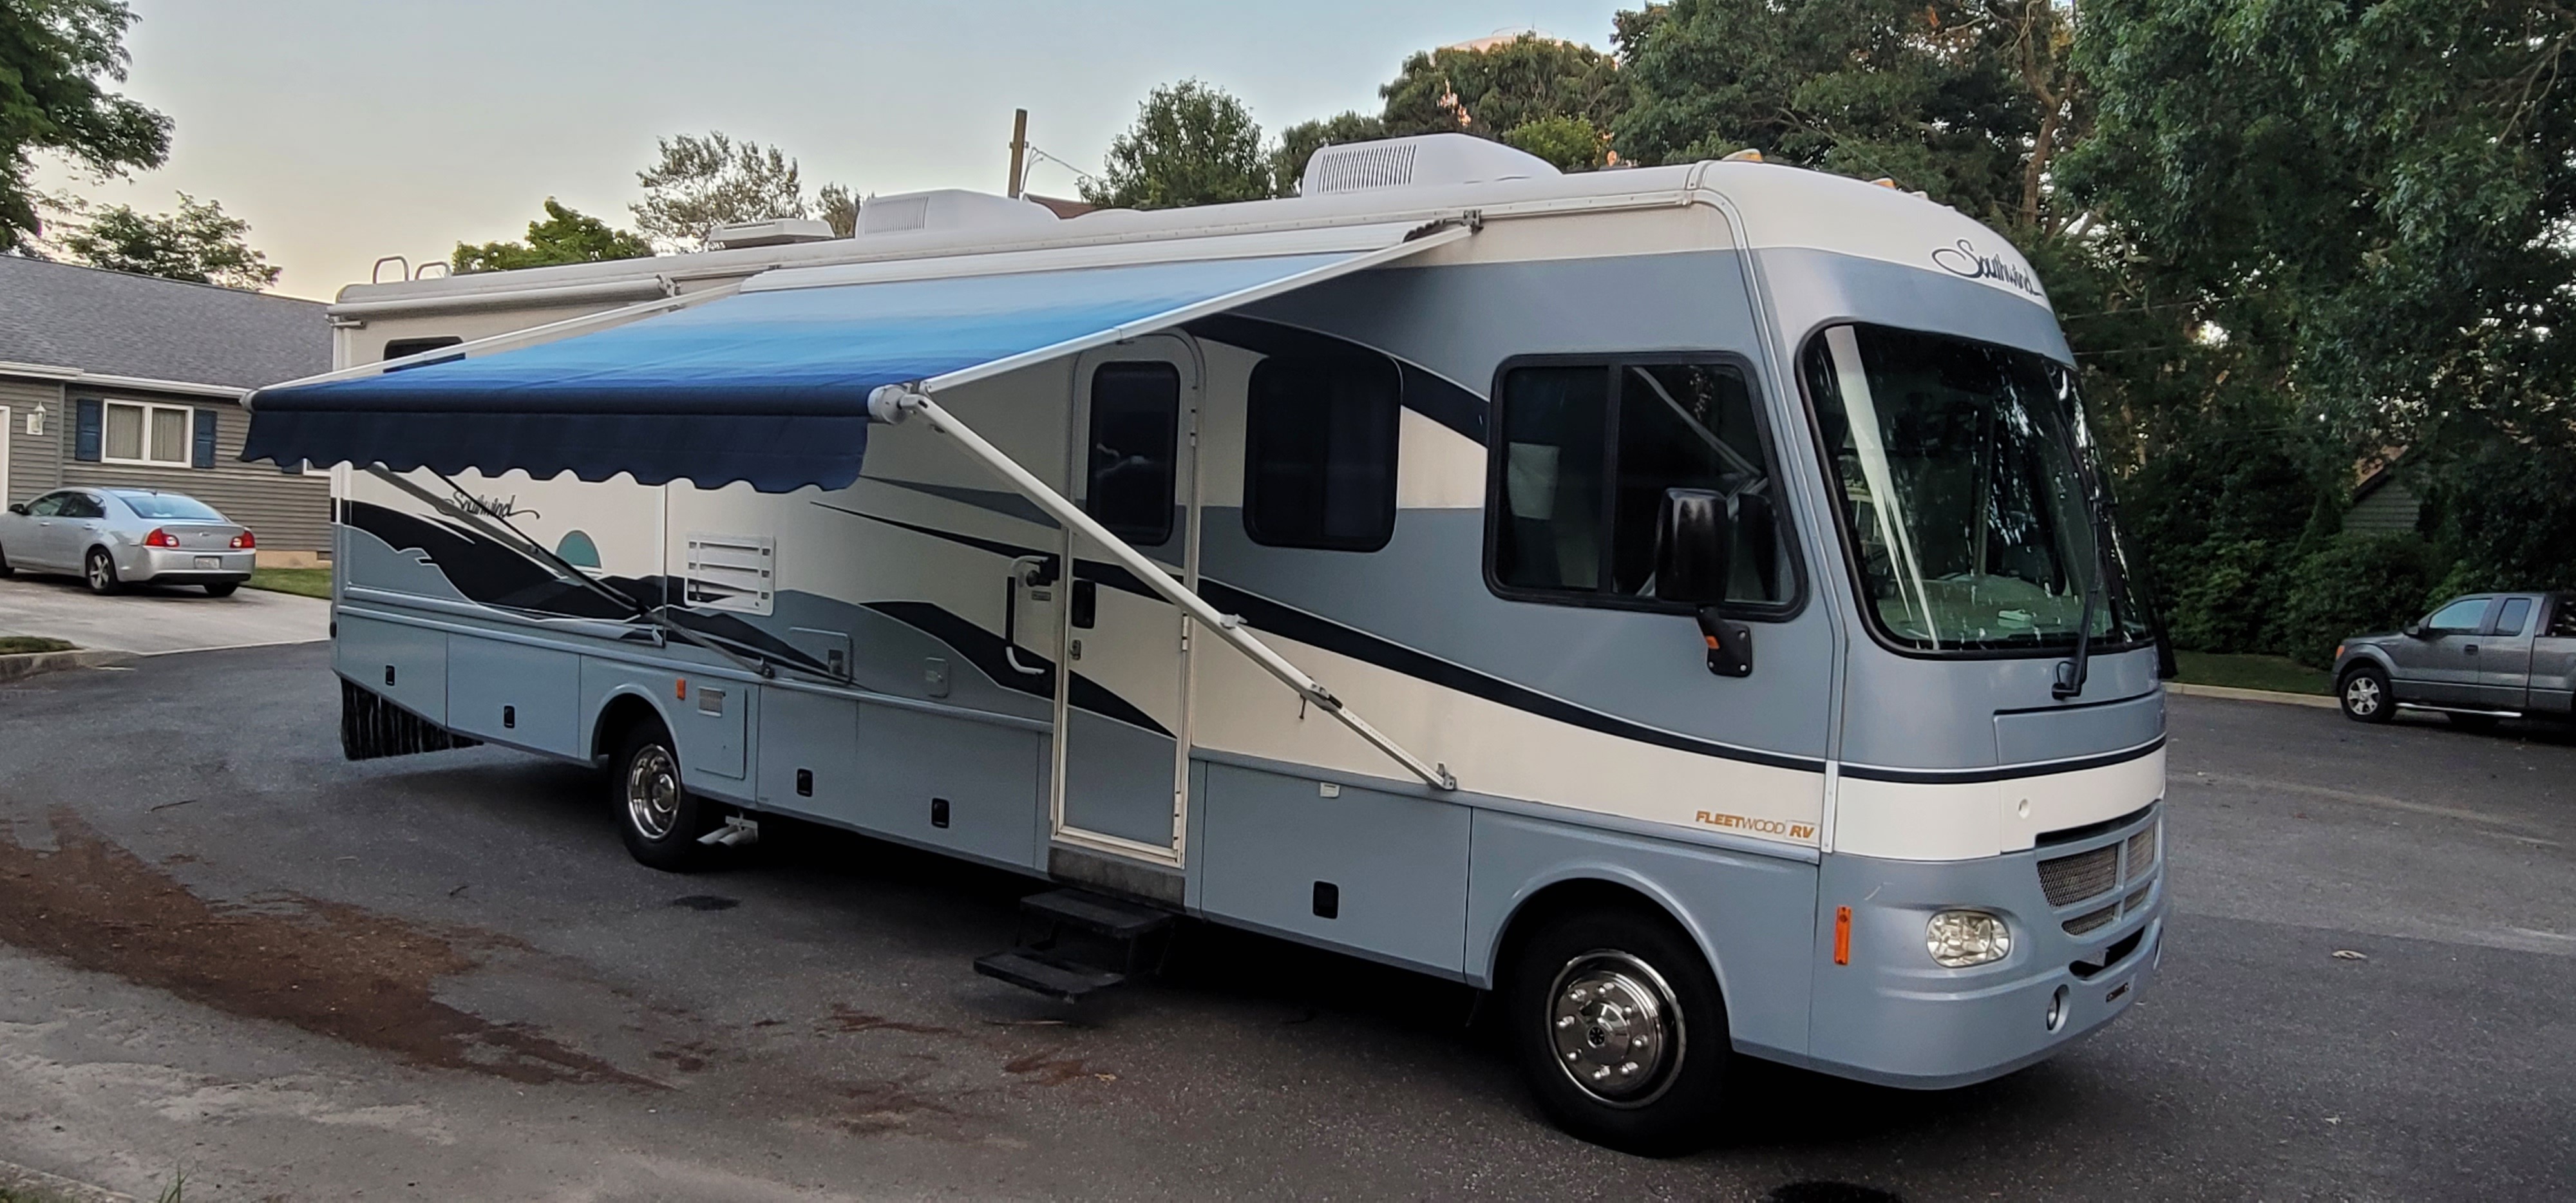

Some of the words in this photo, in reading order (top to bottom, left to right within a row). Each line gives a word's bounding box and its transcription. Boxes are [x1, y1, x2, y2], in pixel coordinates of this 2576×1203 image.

[1931, 239, 2045, 297] Southwind
[1696, 810, 1785, 834] FLEETWOOD
[1789, 825, 1815, 838] RV
